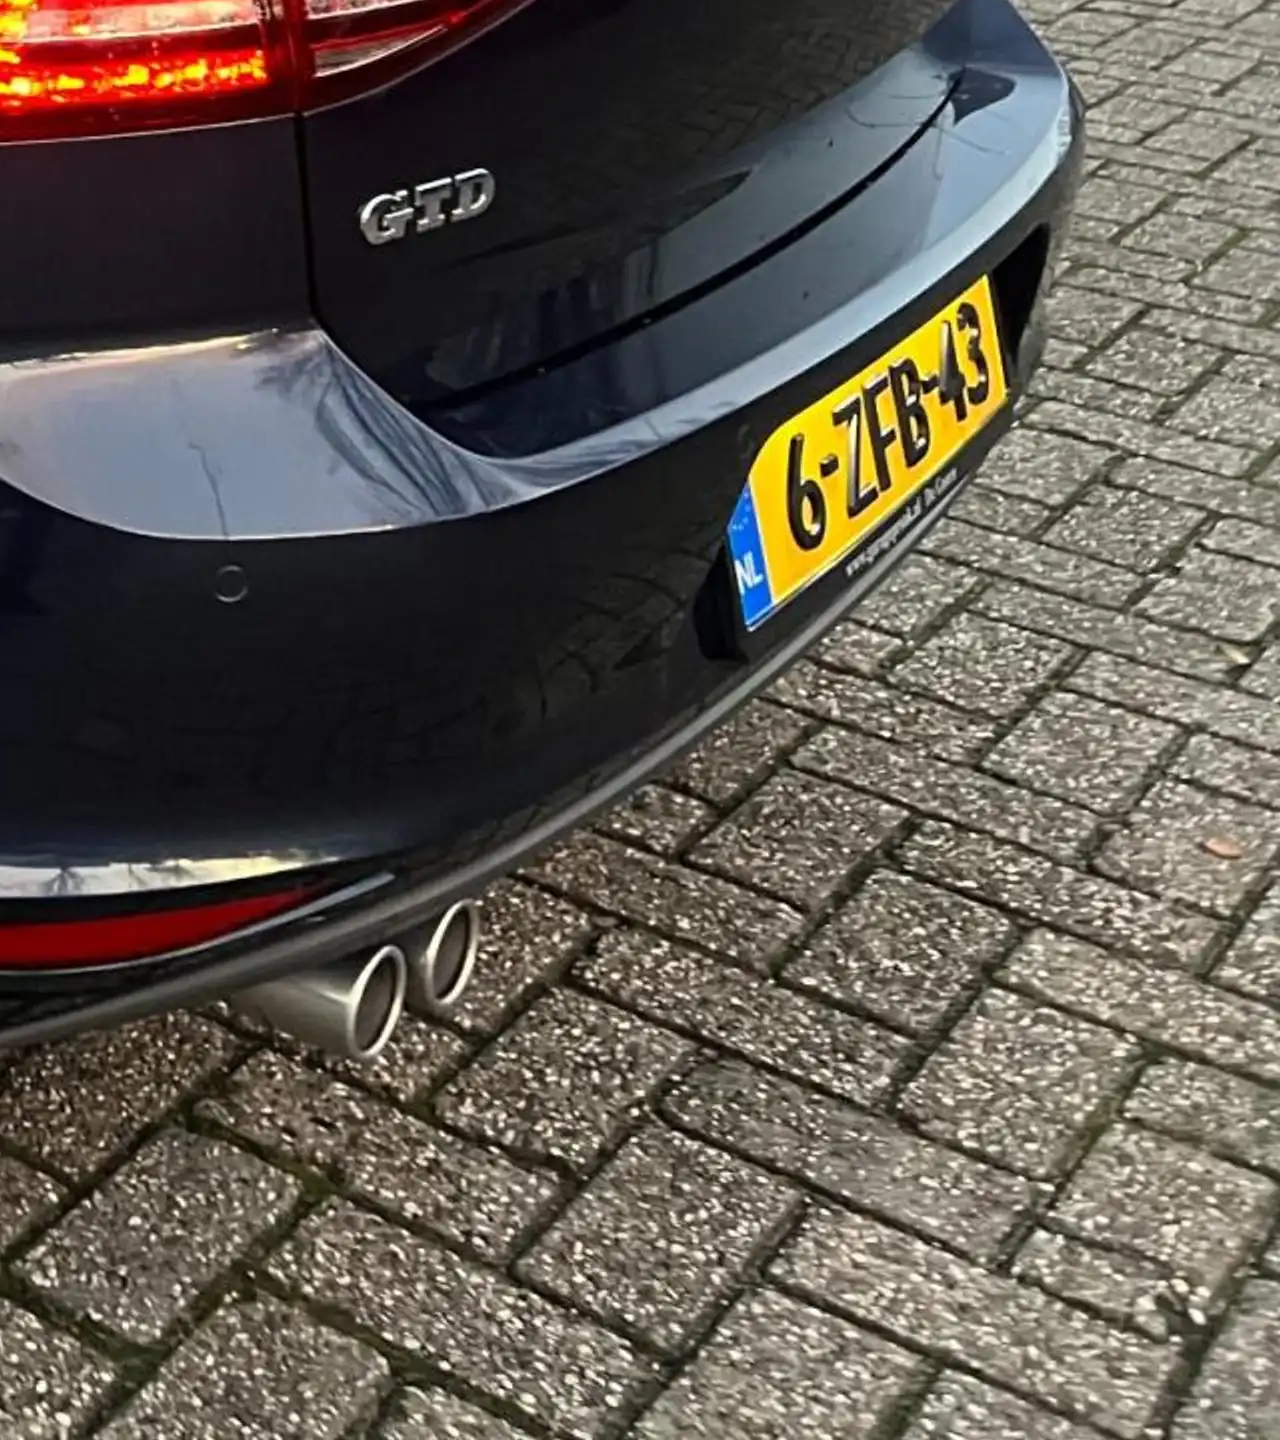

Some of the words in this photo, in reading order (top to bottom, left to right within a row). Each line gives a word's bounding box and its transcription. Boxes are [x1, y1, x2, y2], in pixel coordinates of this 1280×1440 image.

[359, 166, 497, 247] GTD
[786, 301, 990, 552] 6-ZFB-43
[736, 550, 764, 595] NL
